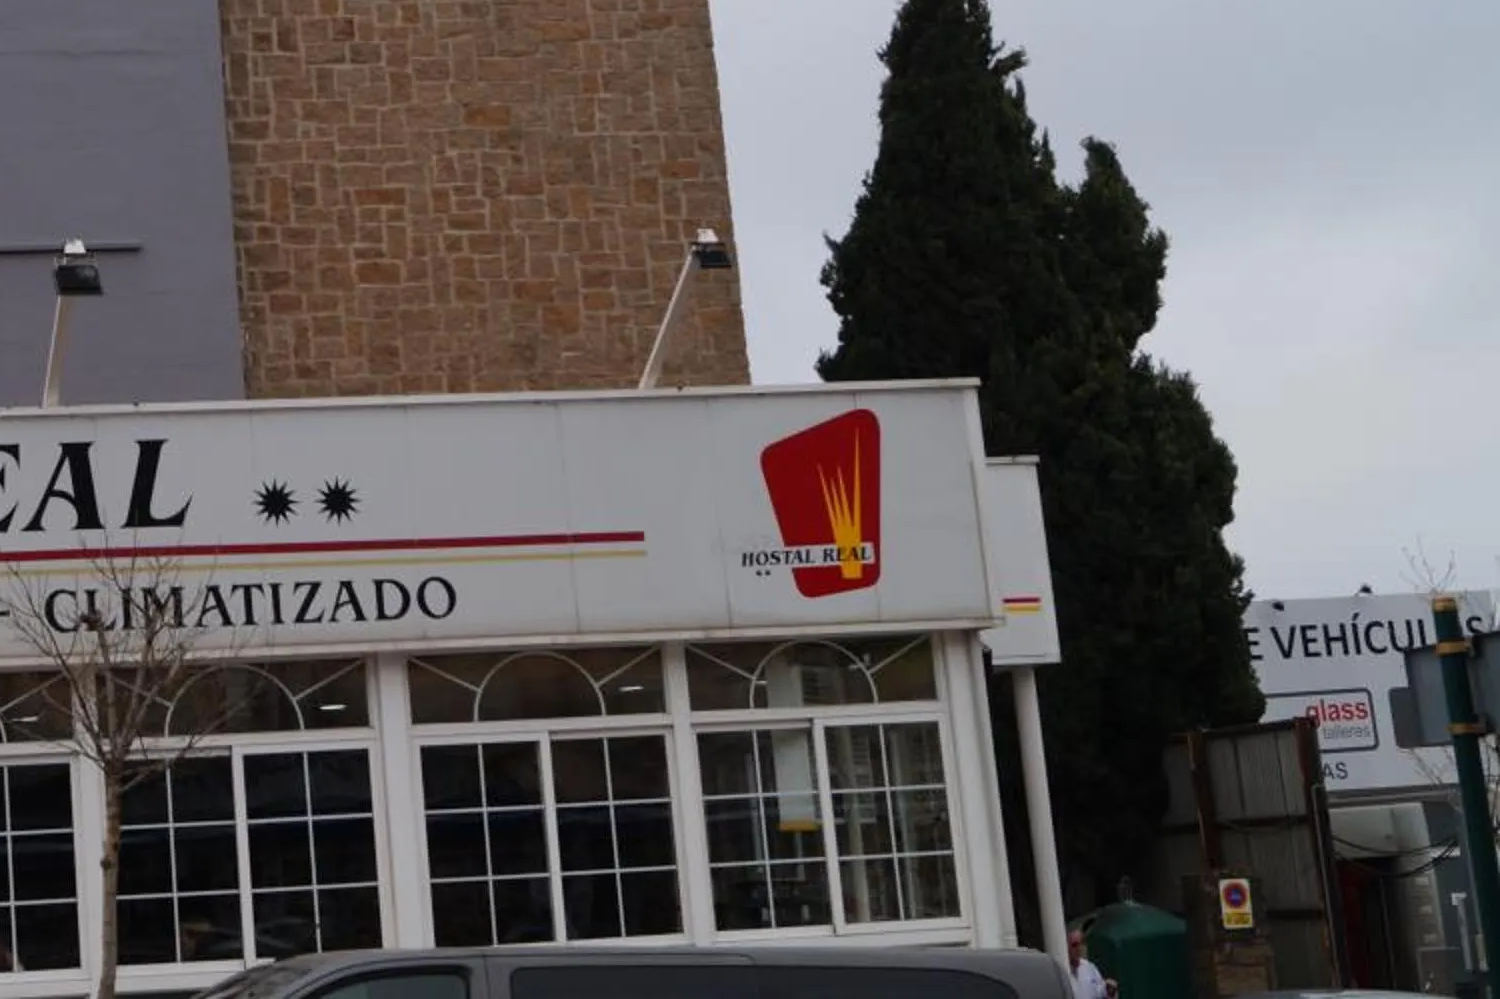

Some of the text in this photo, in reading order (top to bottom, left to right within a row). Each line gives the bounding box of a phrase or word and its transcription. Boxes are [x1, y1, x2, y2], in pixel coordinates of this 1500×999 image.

[741, 545, 872, 567] HOSTAL REAL
[43, 576, 458, 634] CLIMATIZADO
[1270, 612, 1484, 660] VEHÍCULS
[1305, 698, 1369, 728] glass
